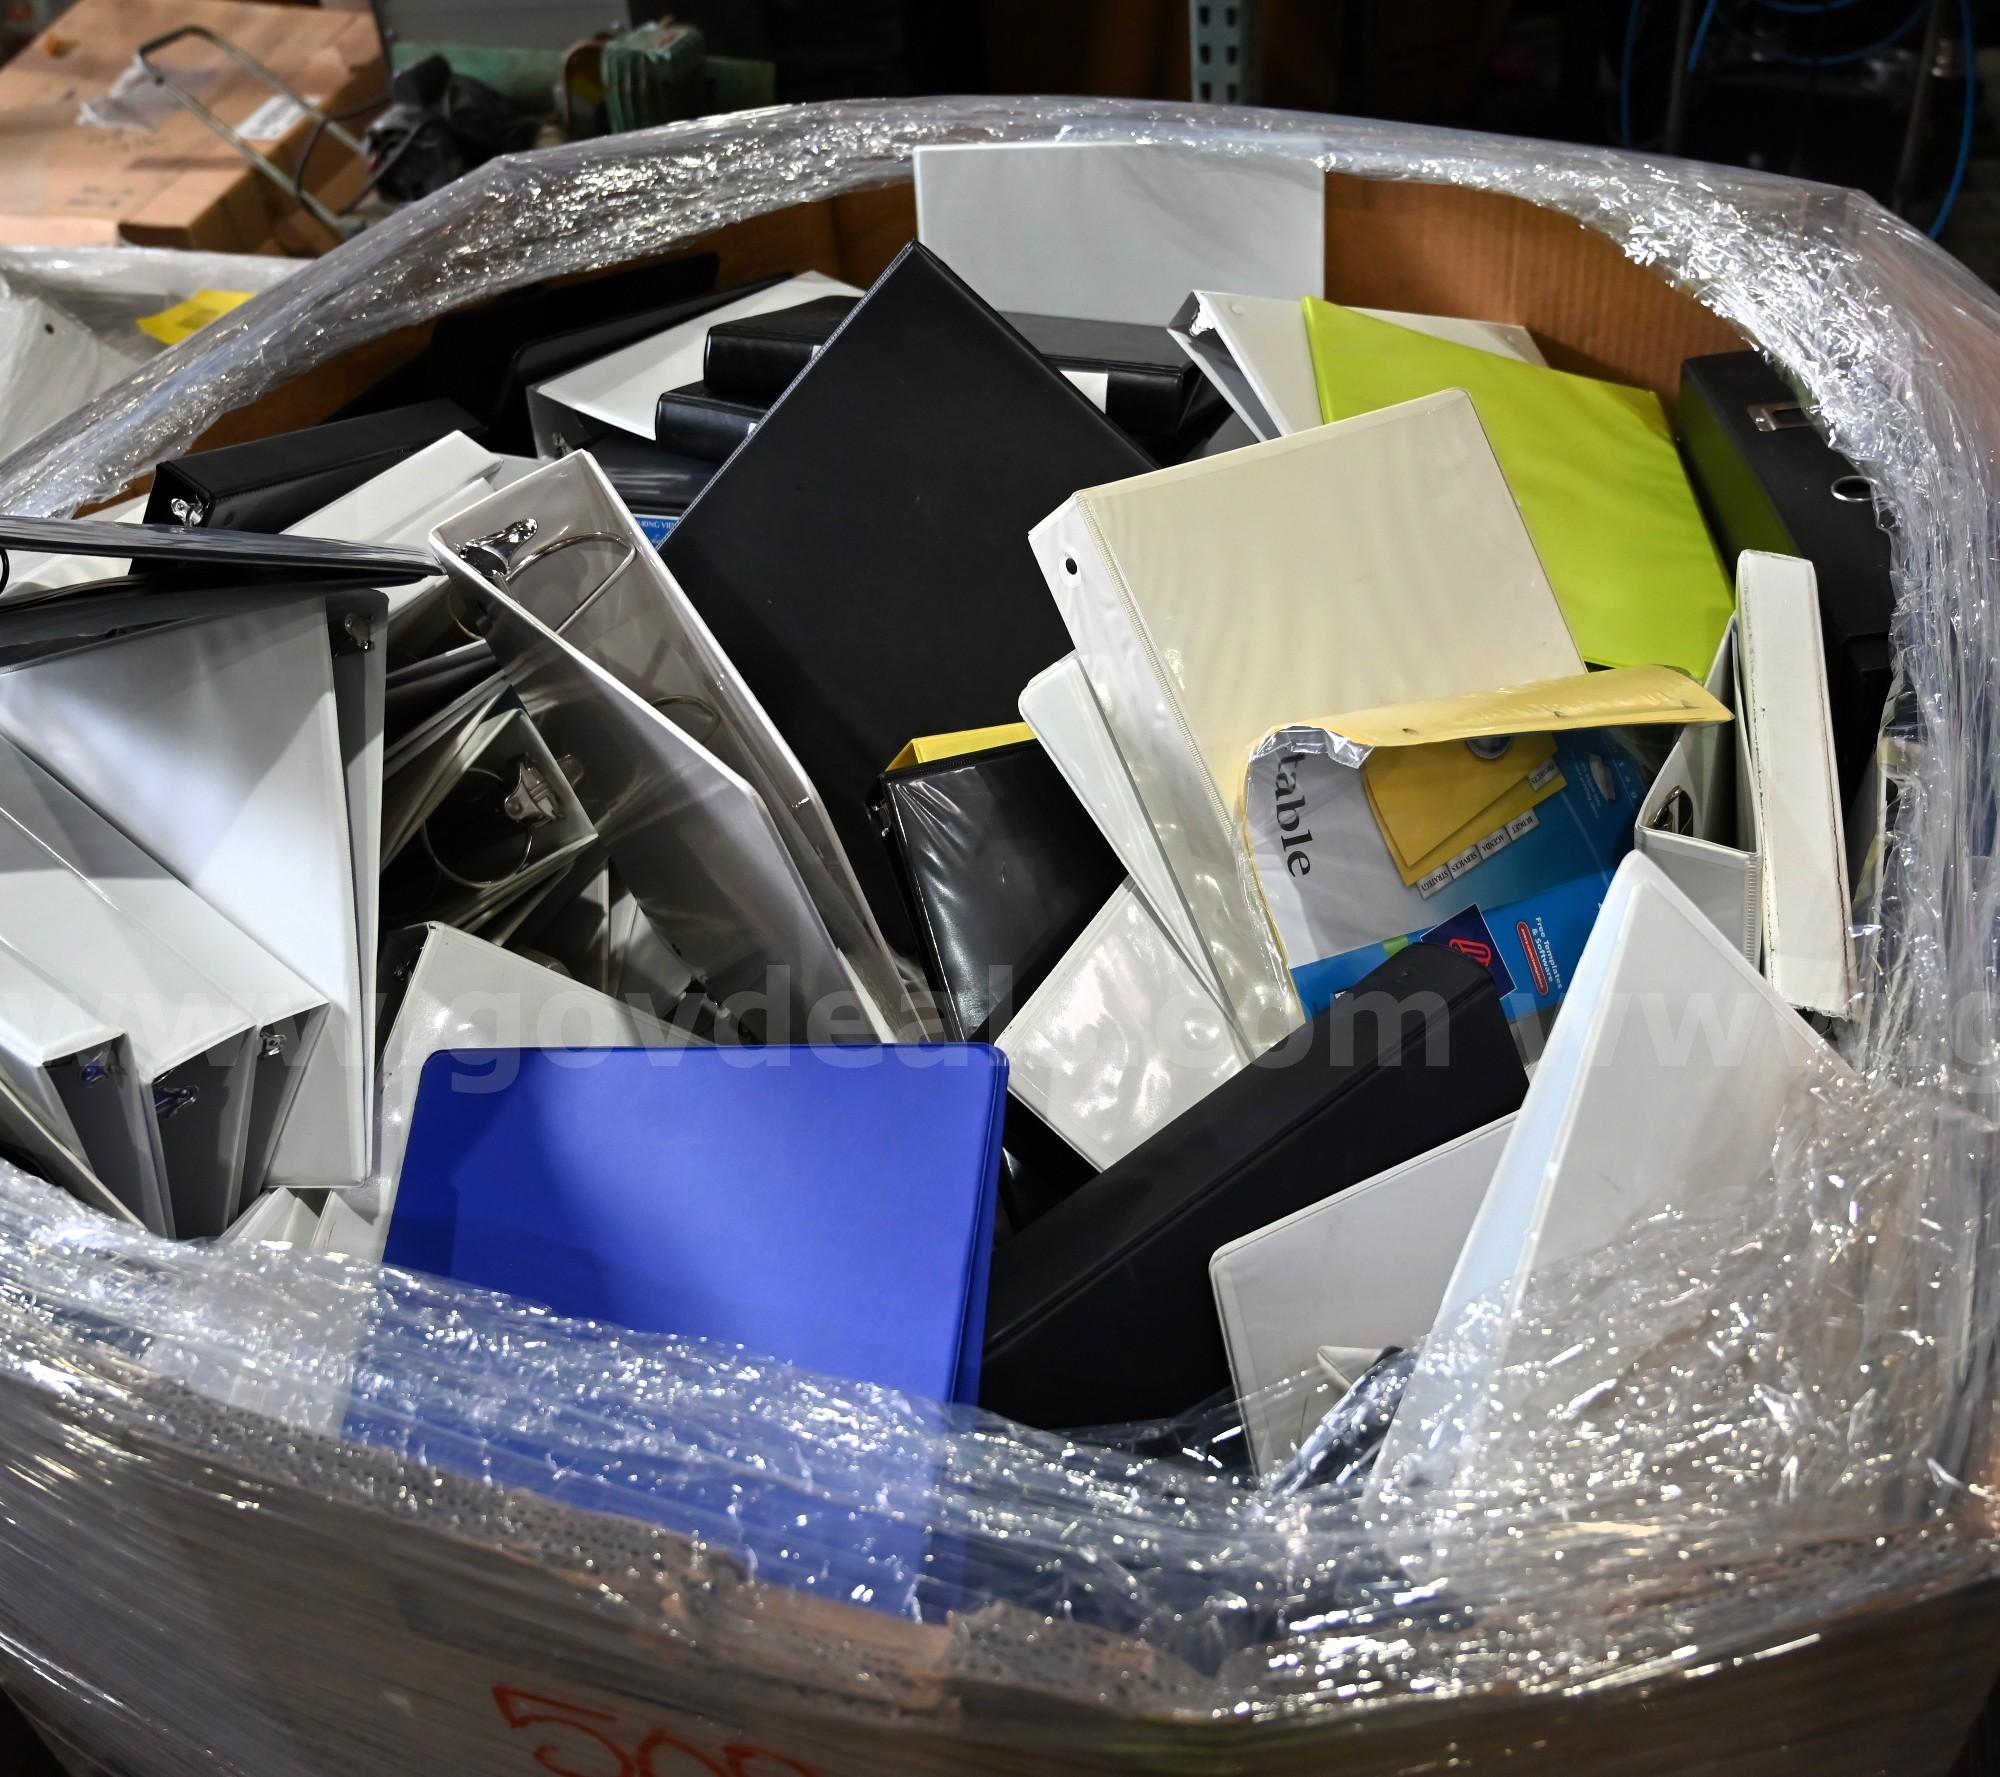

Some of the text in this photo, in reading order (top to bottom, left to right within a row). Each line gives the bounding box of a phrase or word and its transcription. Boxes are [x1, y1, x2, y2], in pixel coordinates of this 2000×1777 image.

[1275, 751, 1313, 877] table
[1512, 815, 1533, 834] BUDGET
[1481, 833, 1505, 852] AGENDA
[1451, 851, 1478, 873] SERVICES
[1420, 870, 1449, 892] STRATEGY
[1534, 937, 1553, 983] Software
[1535, 916, 1563, 990] Free Templates
